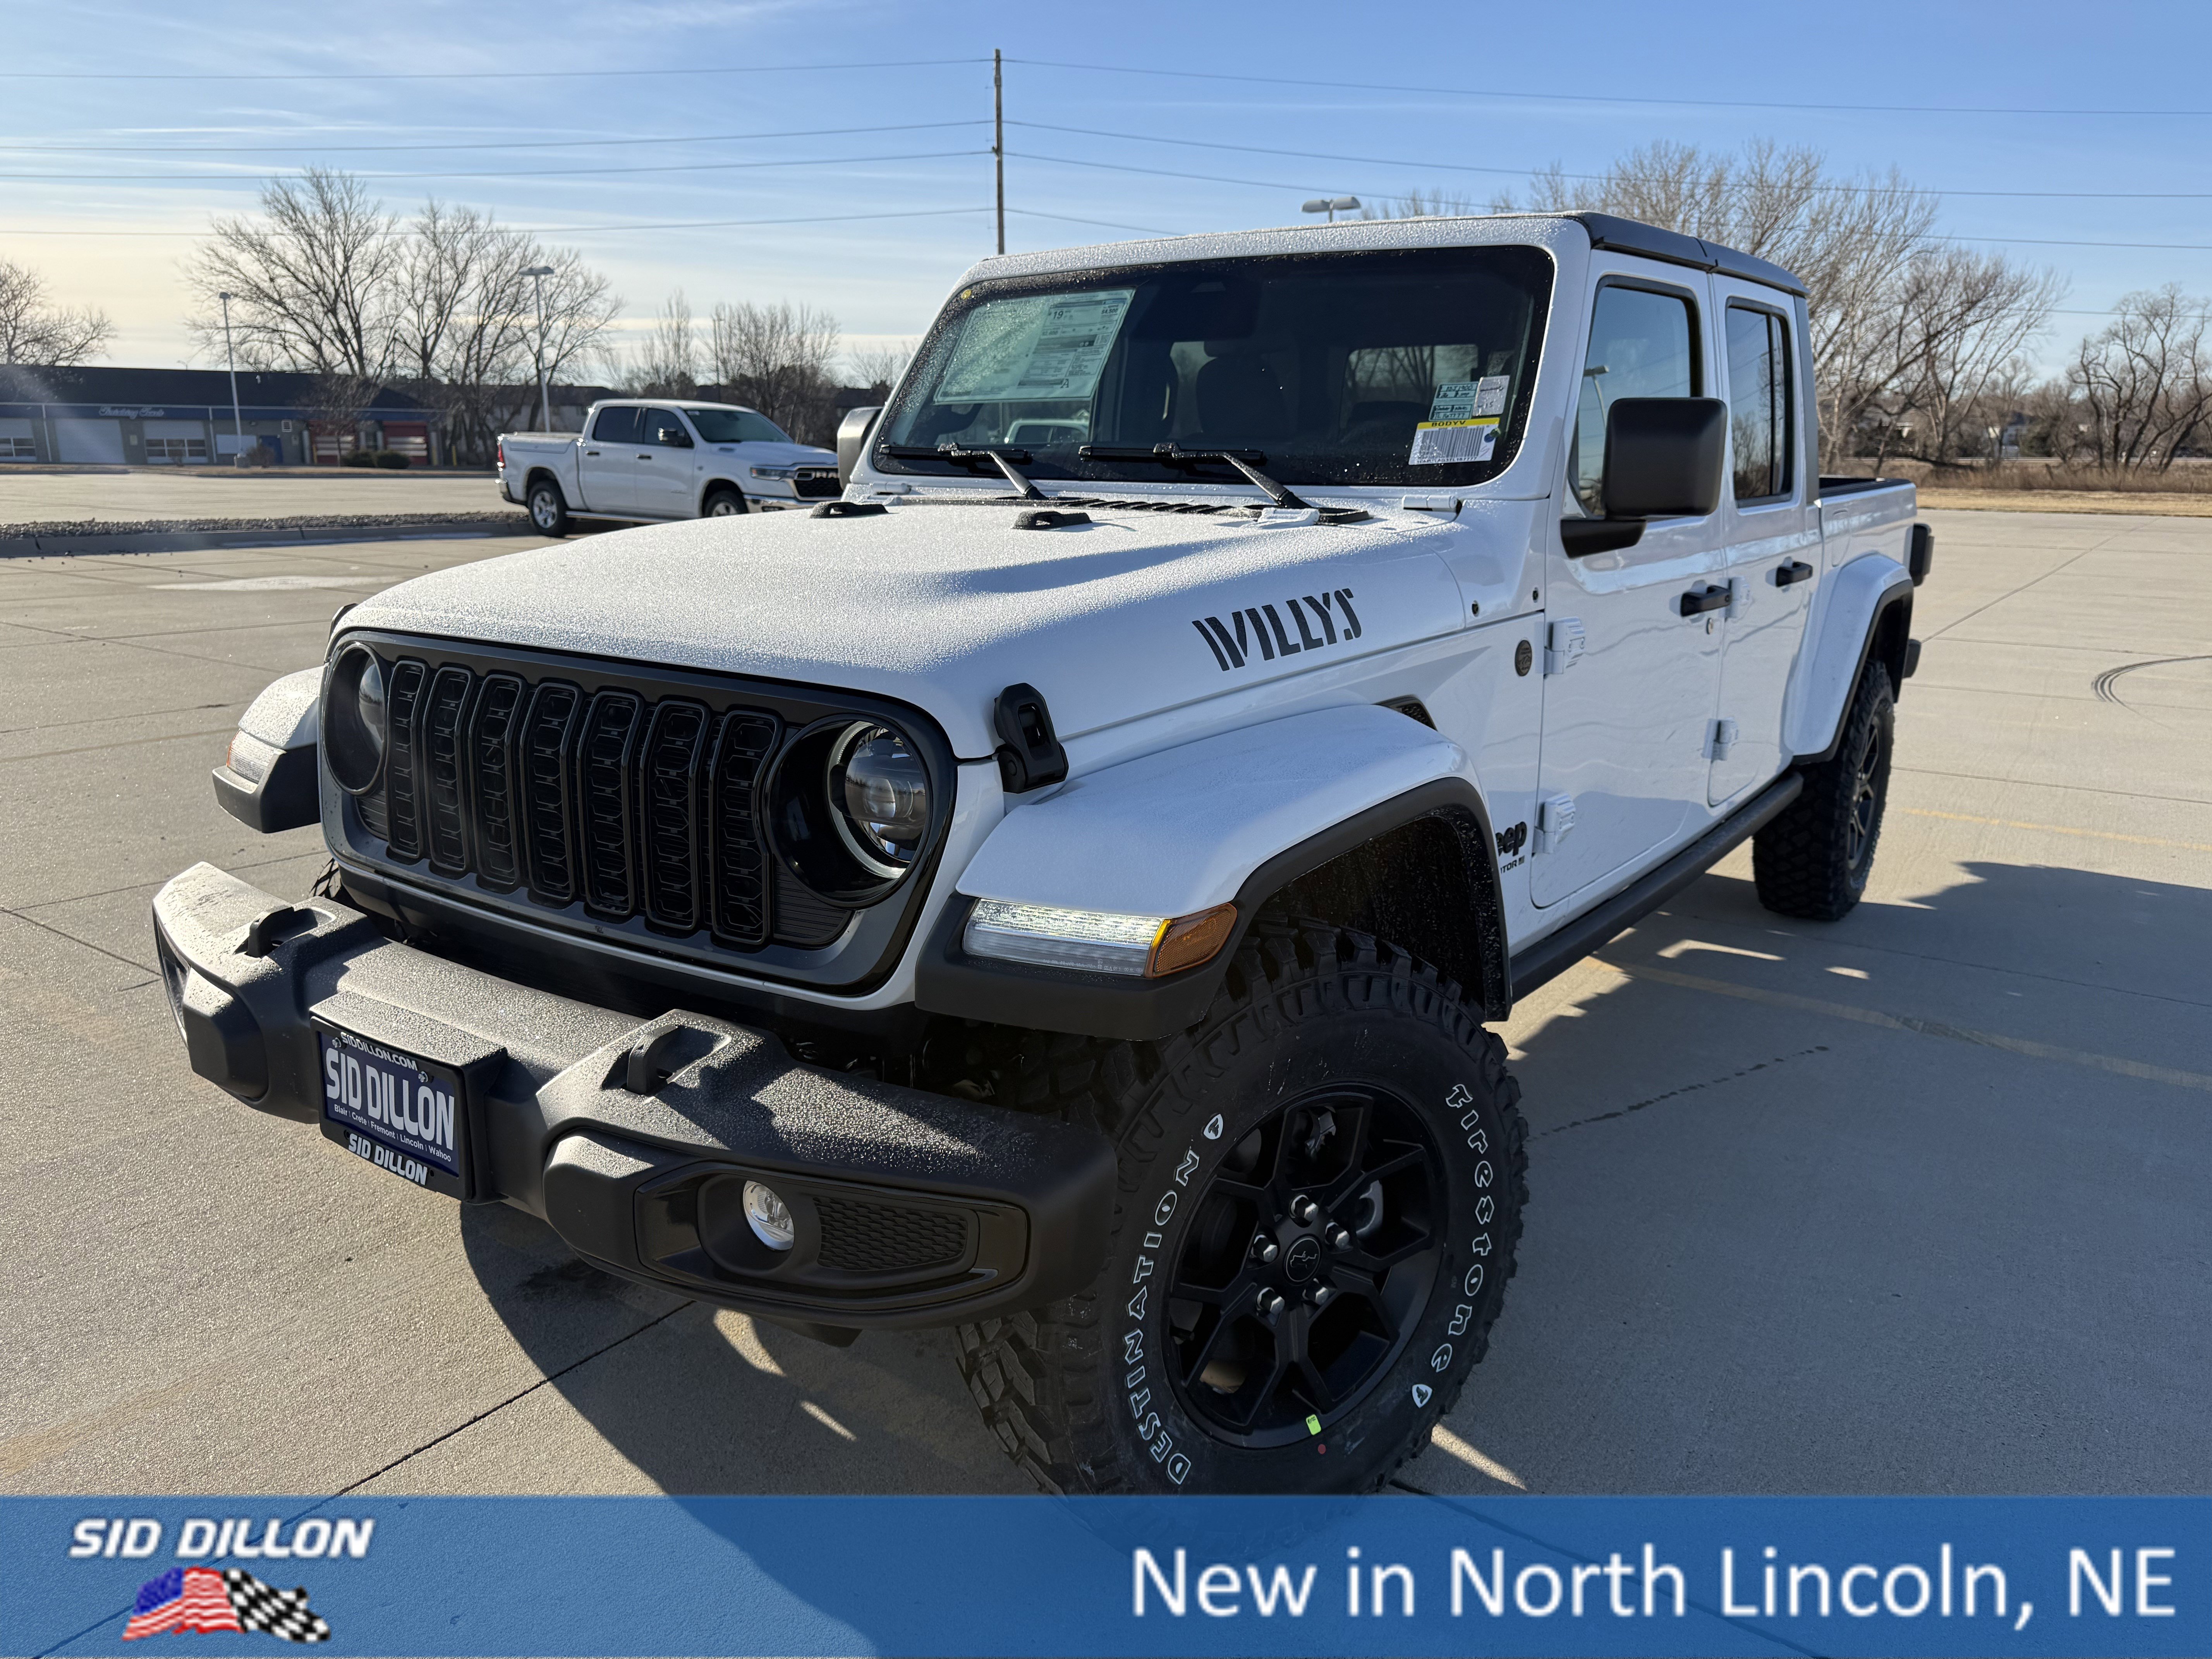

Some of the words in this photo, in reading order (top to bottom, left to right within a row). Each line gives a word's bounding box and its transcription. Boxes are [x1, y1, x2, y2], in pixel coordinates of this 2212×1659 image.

[1192, 588, 1362, 671] WILLYS
[340, 1032, 418, 1071] SIDDILLON.COM
[326, 1048, 362, 1110] SID
[366, 1064, 454, 1151] DILLON
[334, 1104, 348, 1116] Blair
[352, 1112, 367, 1125] Crete
[370, 1121, 396, 1139] Fremont
[400, 1135, 424, 1151] Lincoln
[429, 1145, 452, 1163] Wahoo
[348, 1133, 371, 1159] SID
[374, 1147, 428, 1185] DILLON
[1430, 1083, 1494, 1373] Firestone
[1123, 1149, 1200, 1485] DESTINATION
